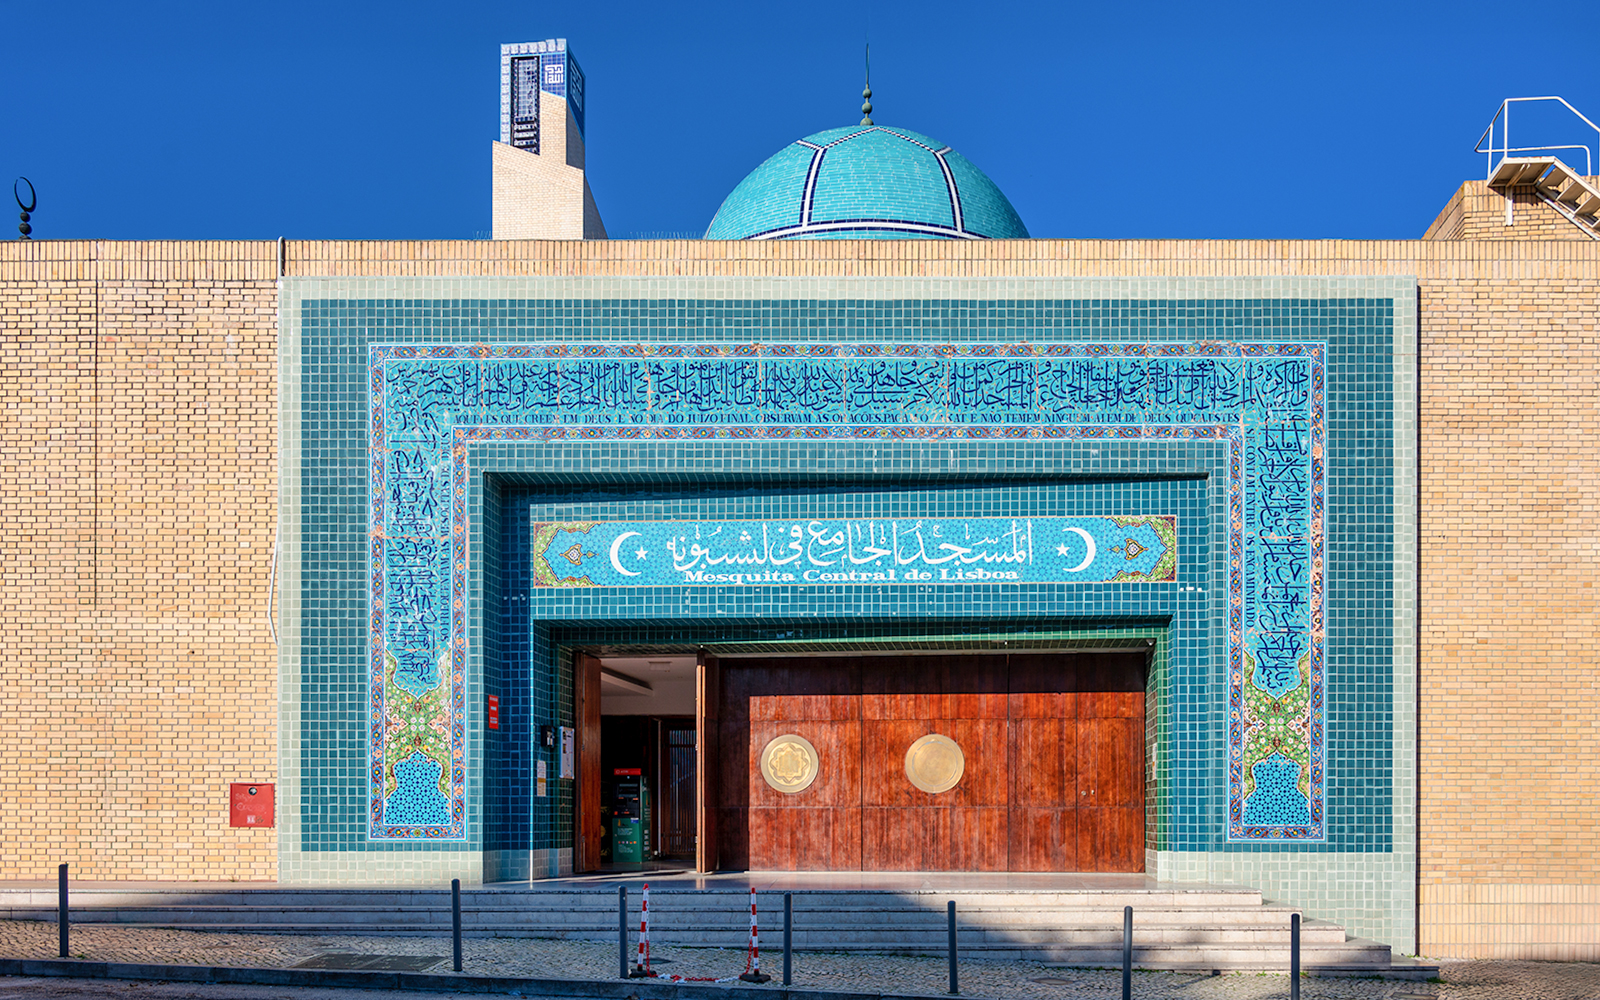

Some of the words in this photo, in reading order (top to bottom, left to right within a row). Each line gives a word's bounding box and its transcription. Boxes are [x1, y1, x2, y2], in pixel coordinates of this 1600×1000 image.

[501, 414, 519, 424] QUE
[564, 414, 578, 424] EM
[585, 414, 611, 424] DEUS
[618, 414, 625, 424] E
[668, 414, 684, 424] DO
[756, 414, 811, 424] OBSERVAM
[816, 414, 830, 424] AS
[920, 414, 929, 424] O
[971, 414, 977, 424] E
[1006, 414, 1040, 424] TEMEM
[1145, 414, 1171, 424] DEUS
[1246, 428, 1254, 443] SE
[440, 432, 449, 460] DEUS
[1246, 446, 1254, 488] CONTAM
[1246, 493, 1254, 528] ENTRE
[1246, 532, 1254, 546] OS
[440, 542, 449, 554] AS
[684, 570, 795, 585] Mesquita
[803, 569, 897, 582] Central
[904, 568, 932, 580] de
[939, 568, 1019, 580] Lisboa
[440, 628, 449, 642] SO
